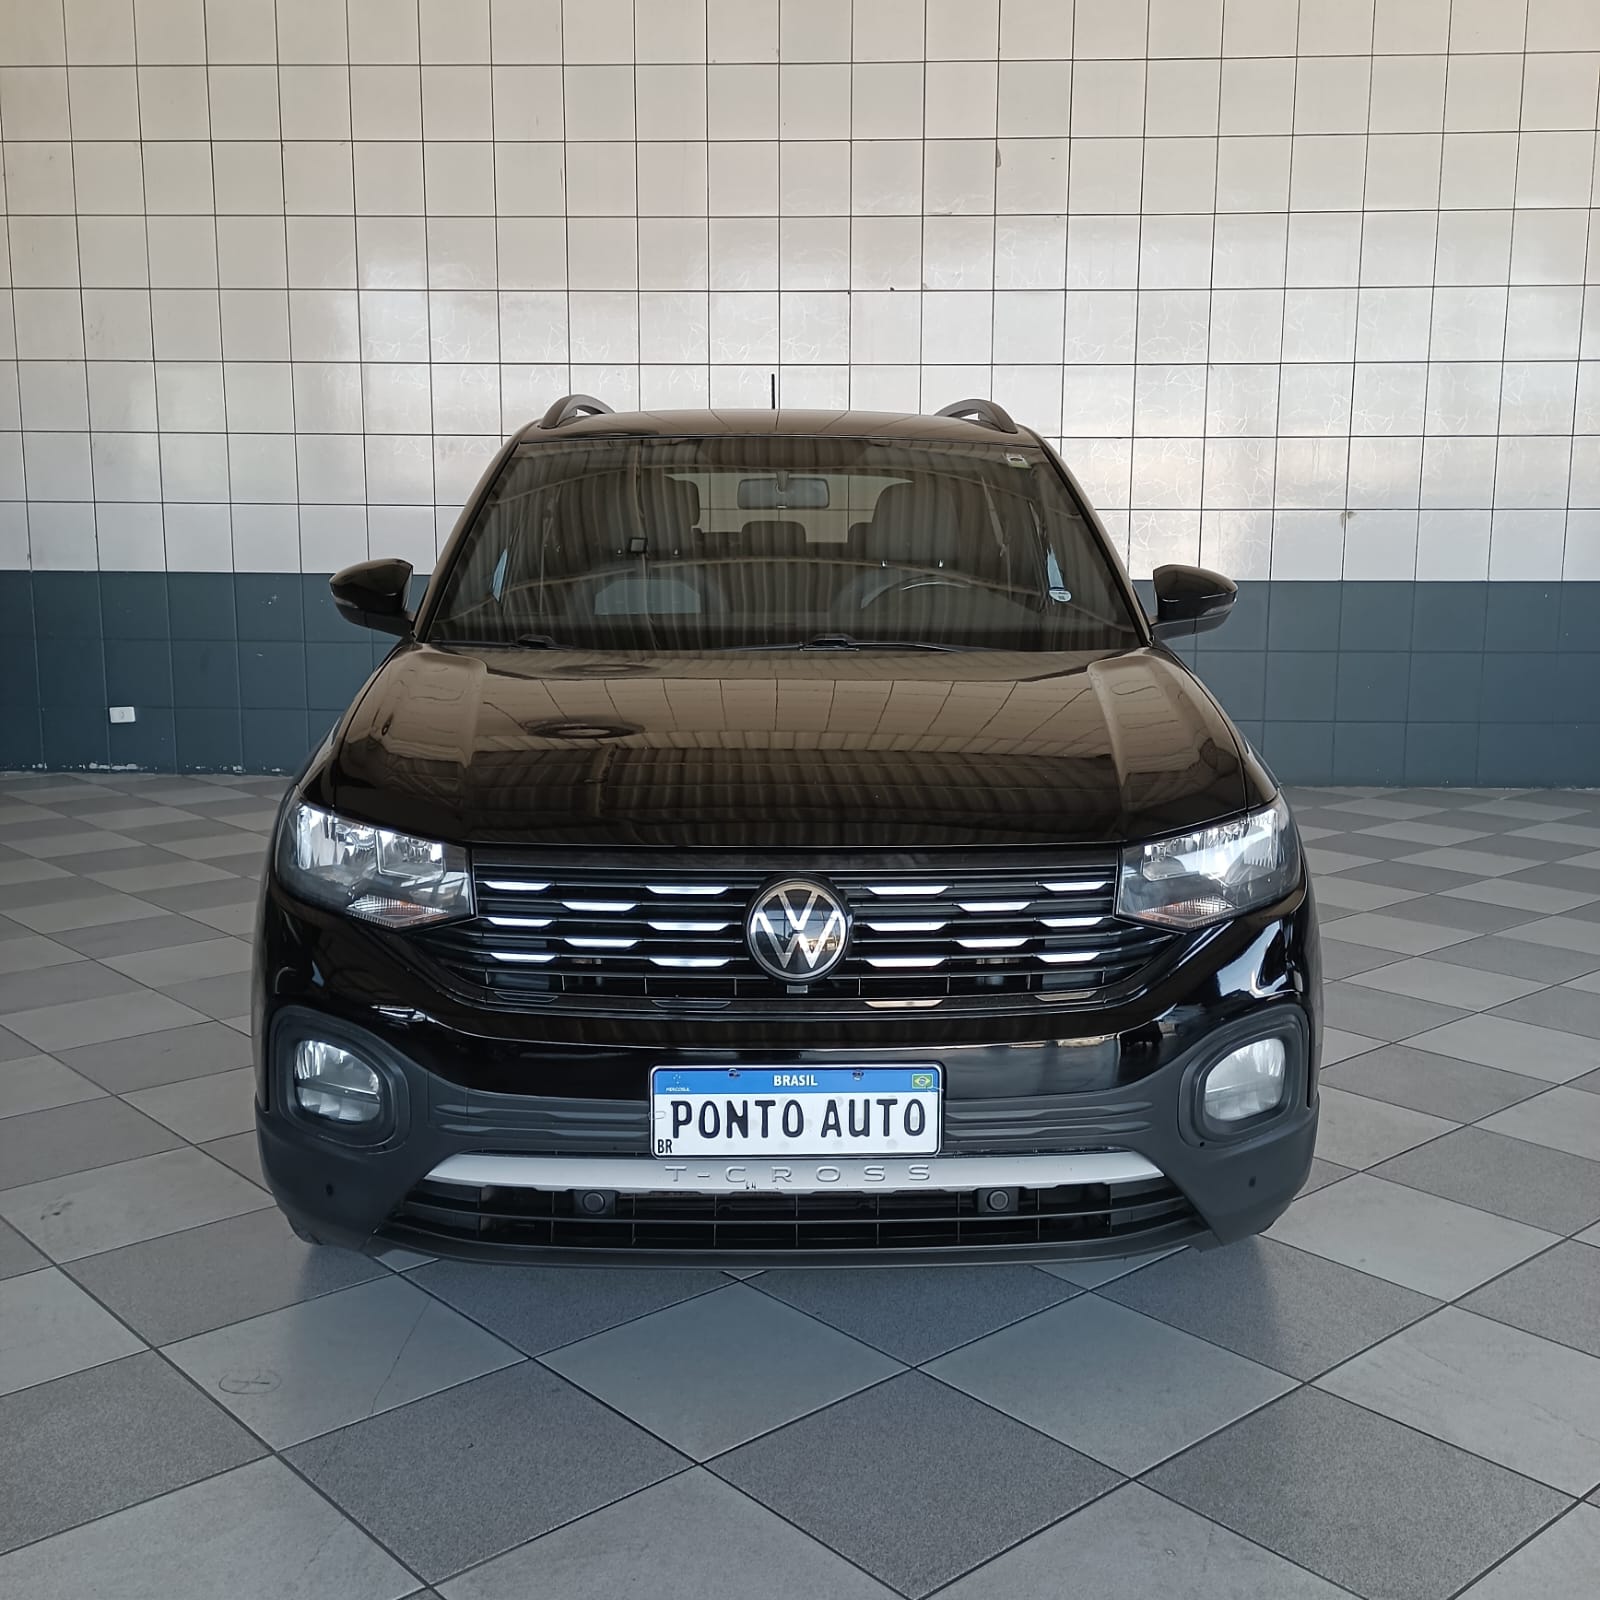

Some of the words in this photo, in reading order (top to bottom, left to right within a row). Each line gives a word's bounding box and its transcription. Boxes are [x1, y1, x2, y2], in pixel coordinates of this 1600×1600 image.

[773, 1074, 818, 1087] BRASIL
[670, 1098, 804, 1139] PONTO
[820, 1098, 926, 1138] AUTO
[657, 1138, 673, 1154] BR
[665, 1164, 931, 1183] T-CROSS
